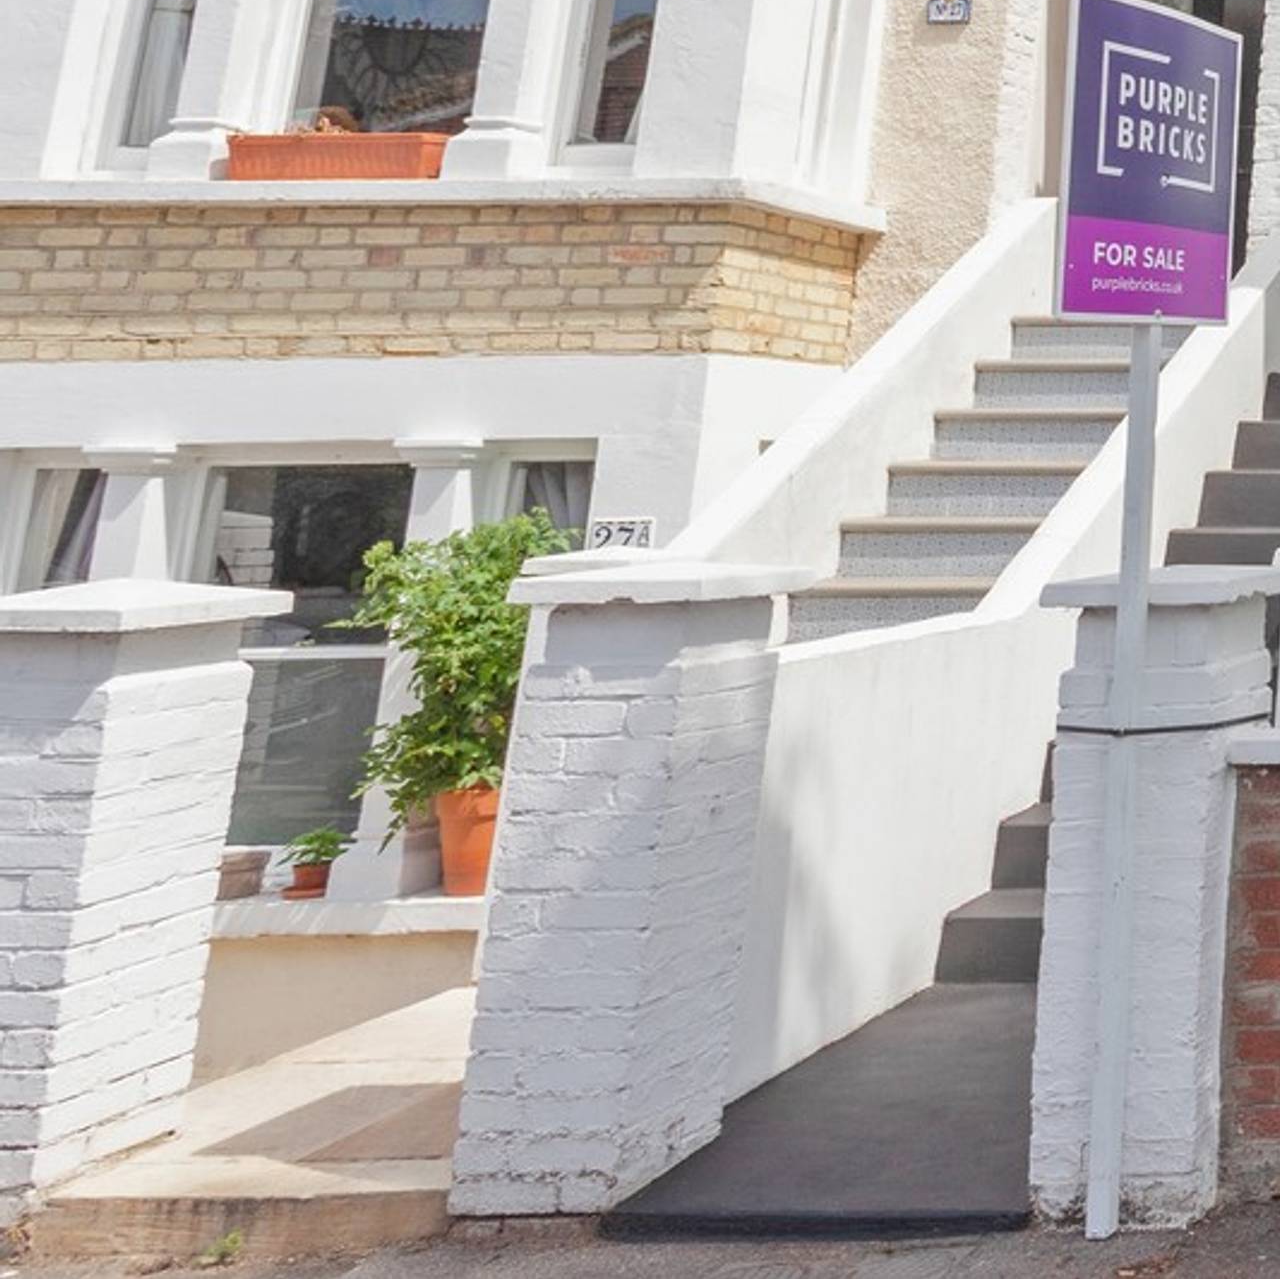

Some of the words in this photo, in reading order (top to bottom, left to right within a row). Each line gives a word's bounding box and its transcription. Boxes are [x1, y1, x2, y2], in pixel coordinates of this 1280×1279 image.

[1119, 72, 1208, 124] PURPLE
[1117, 115, 1206, 164] BRICKS
[1093, 241, 1137, 268] FOR
[1142, 246, 1185, 271] SALE
